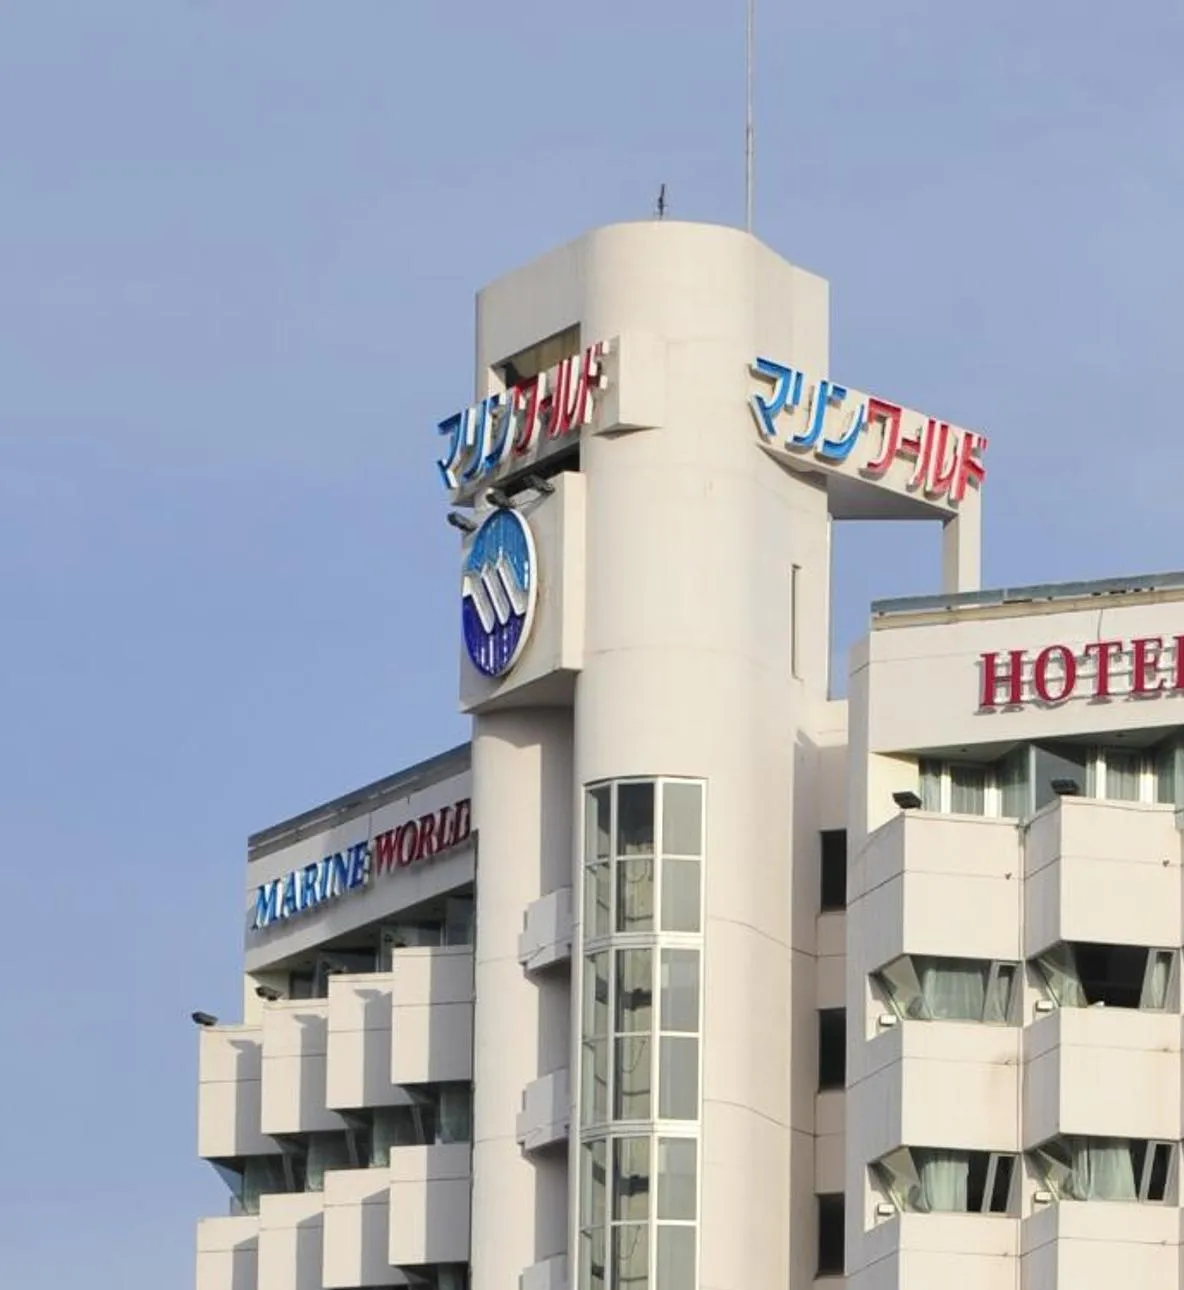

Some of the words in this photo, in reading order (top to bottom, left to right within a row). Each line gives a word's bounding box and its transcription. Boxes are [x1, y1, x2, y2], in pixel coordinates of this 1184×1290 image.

[437, 340, 609, 490] マリンワールド
[749, 356, 988, 502] マリンワールド
[253, 841, 371, 928] MARINE
[374, 798, 471, 876] WORLD
